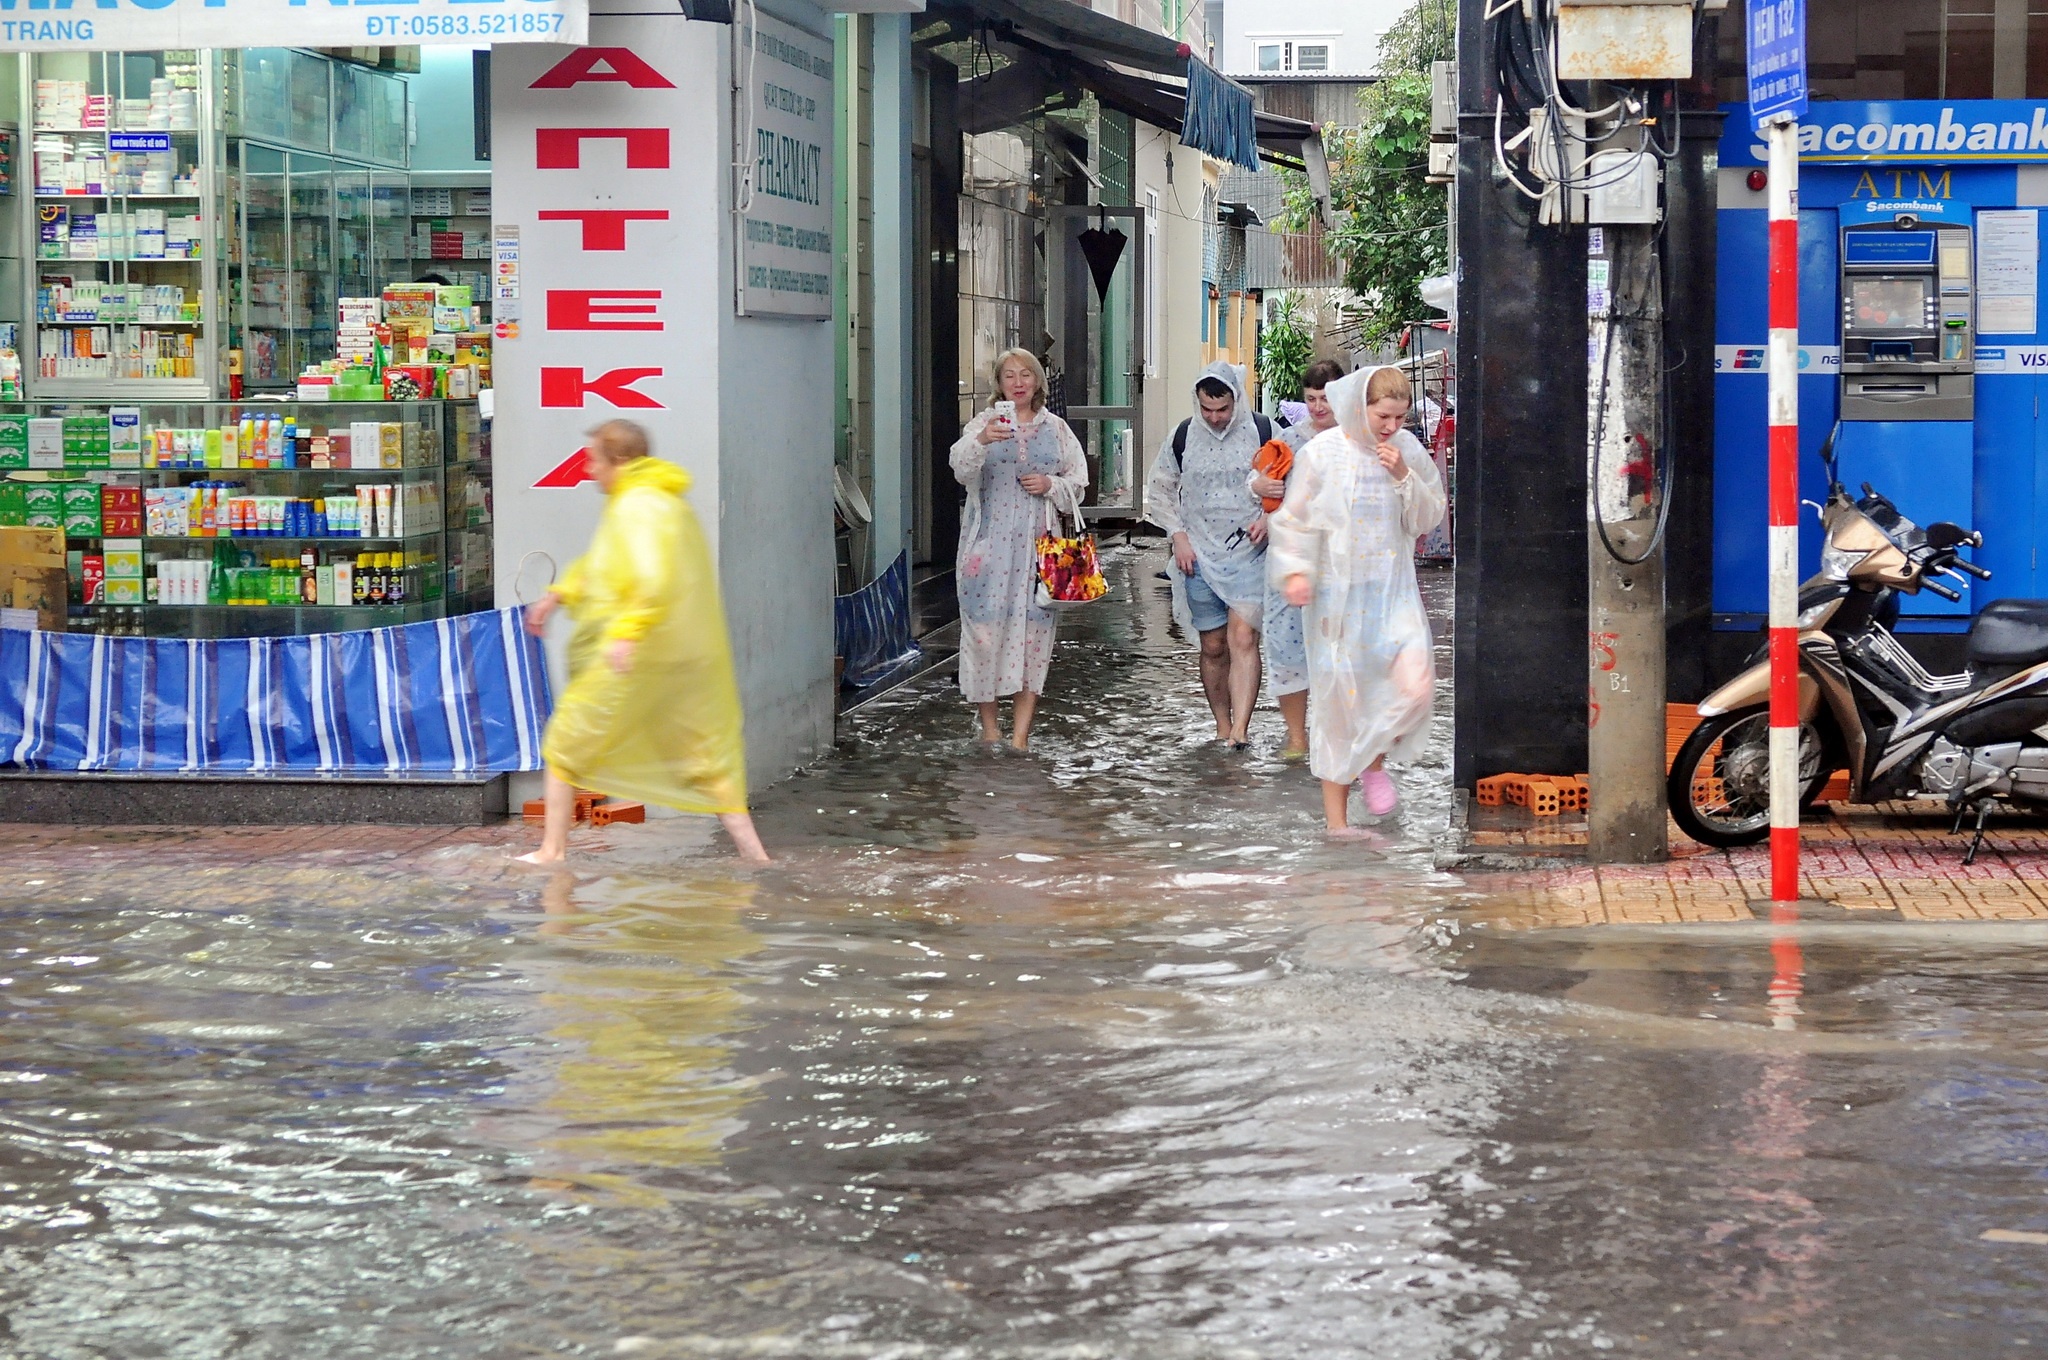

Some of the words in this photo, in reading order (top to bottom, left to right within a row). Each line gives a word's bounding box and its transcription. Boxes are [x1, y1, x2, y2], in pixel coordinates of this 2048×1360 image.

[366, 14, 565, 36] ĐT:0583.521857
[1778, 0, 1795, 38] 132
[2, 20, 93, 40] TRANG
[757, 128, 821, 206] PHARMACY
[1850, 170, 1954, 200] ATM
[1866, 200, 1944, 213] Sacombank
[498, 252, 518, 260] VISA
[2018, 353, 2048, 367] VIS
[1609, 672, 1631, 693] B1
